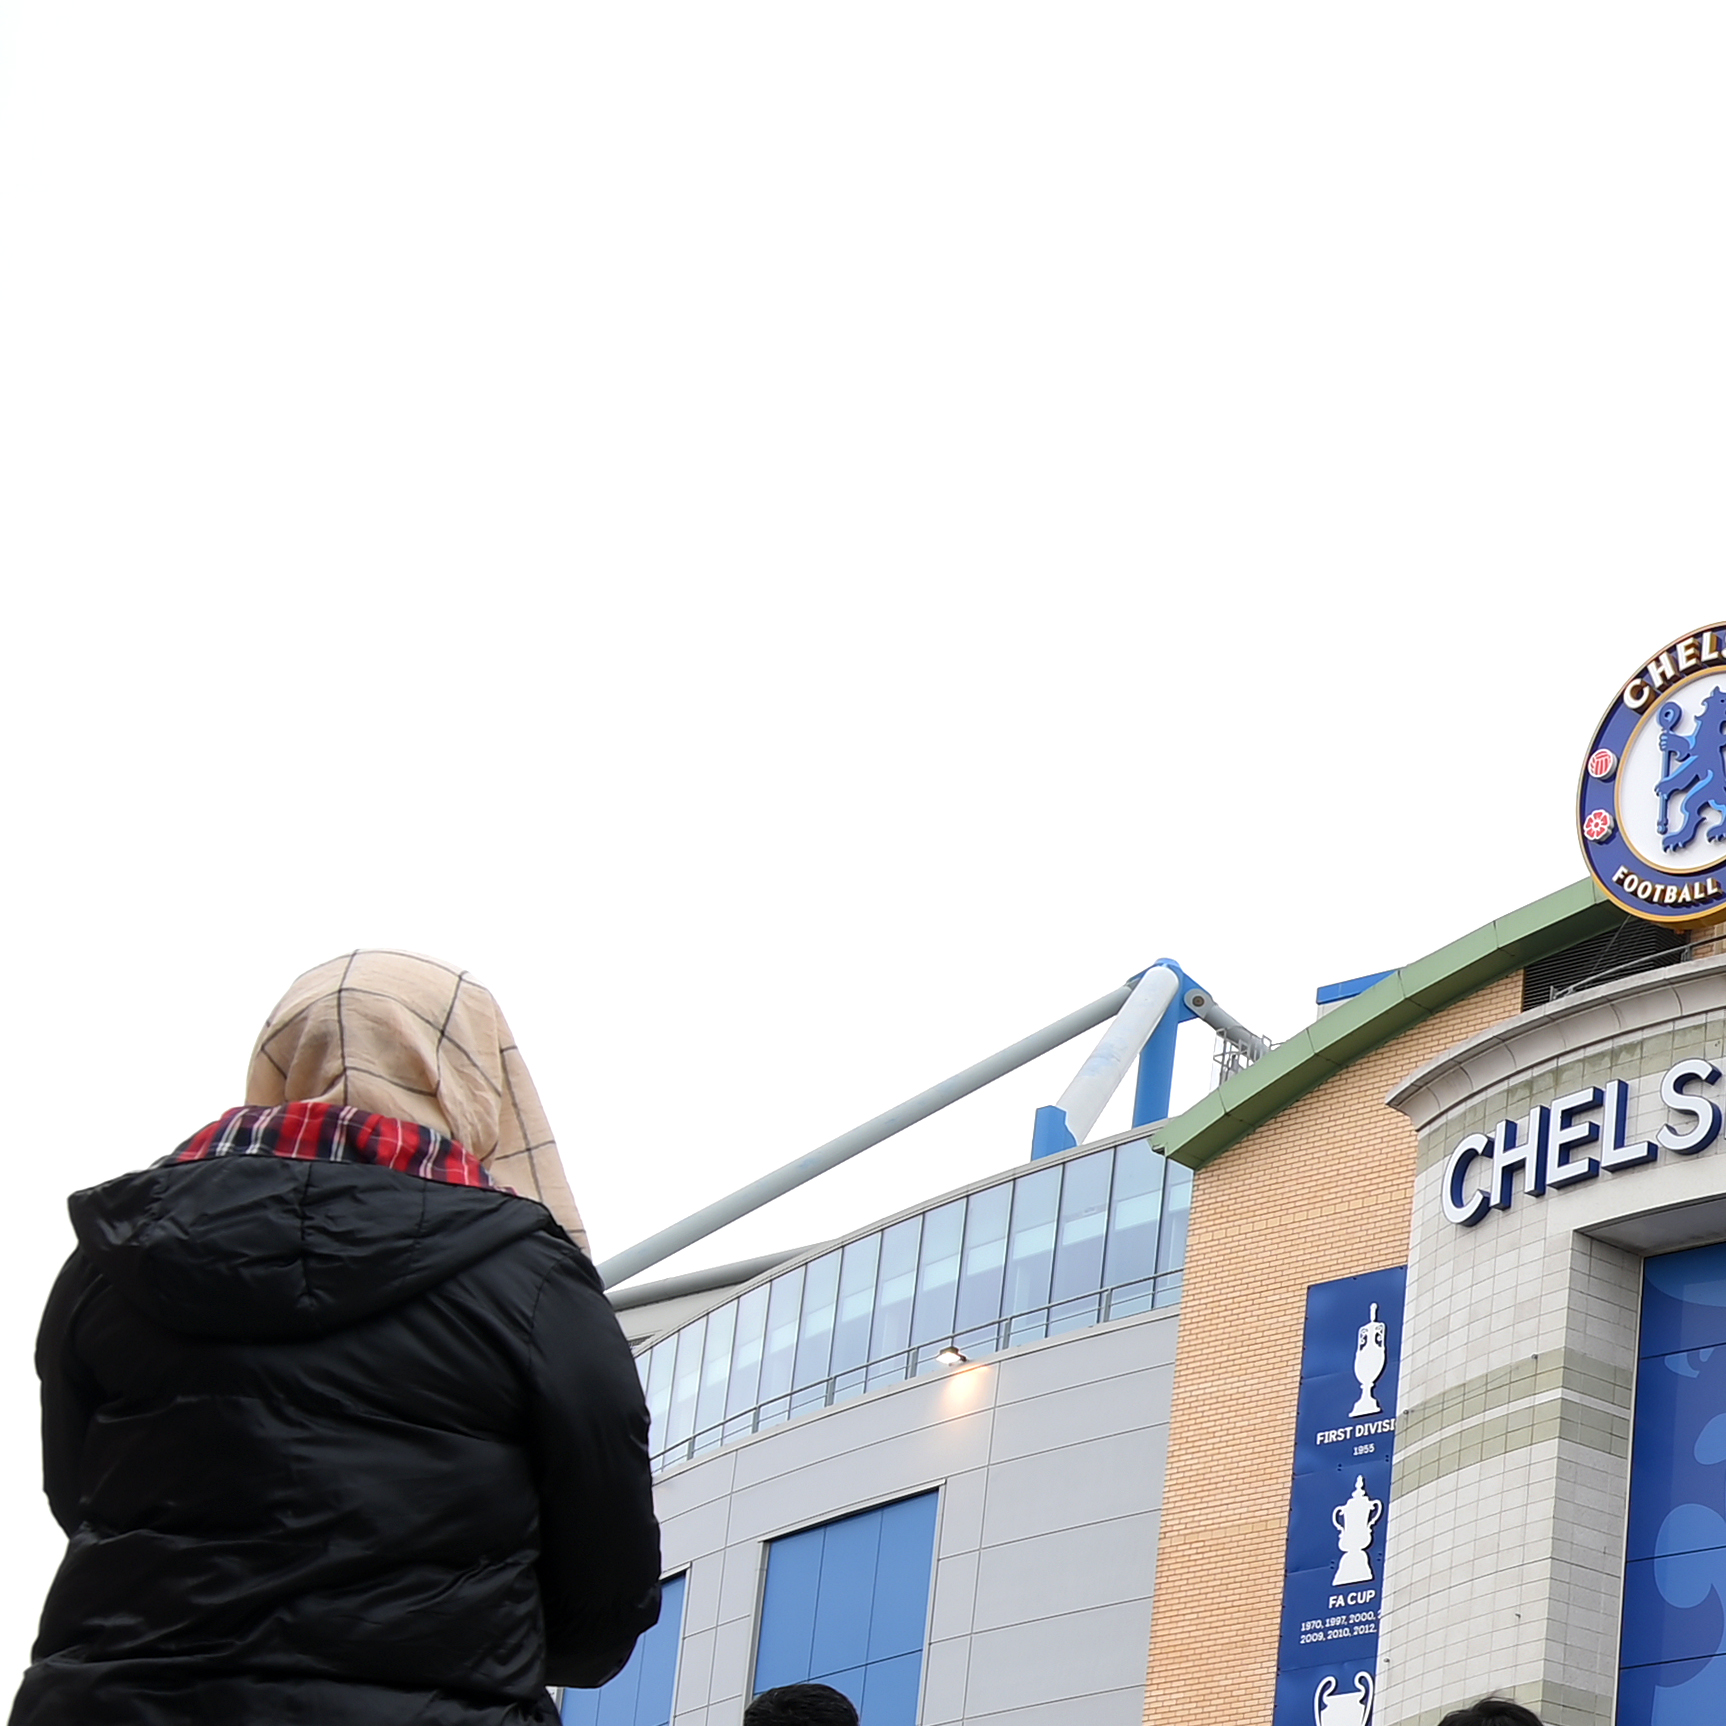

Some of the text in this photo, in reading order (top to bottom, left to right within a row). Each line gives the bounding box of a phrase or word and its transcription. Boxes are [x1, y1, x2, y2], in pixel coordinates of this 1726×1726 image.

[1611, 865, 1720, 903] FOOTBALL
[1316, 1426, 1353, 1445] FIRST
[1353, 1443, 1375, 1456] 1955
[1328, 1590, 1376, 1609] FA CUP
[1301, 1619, 1324, 1631] 1970,
[1325, 1615, 1347, 1628] 1997,
[1300, 1632, 1326, 1644] 2009,
[1327, 1627, 1351, 1640] 2010,
